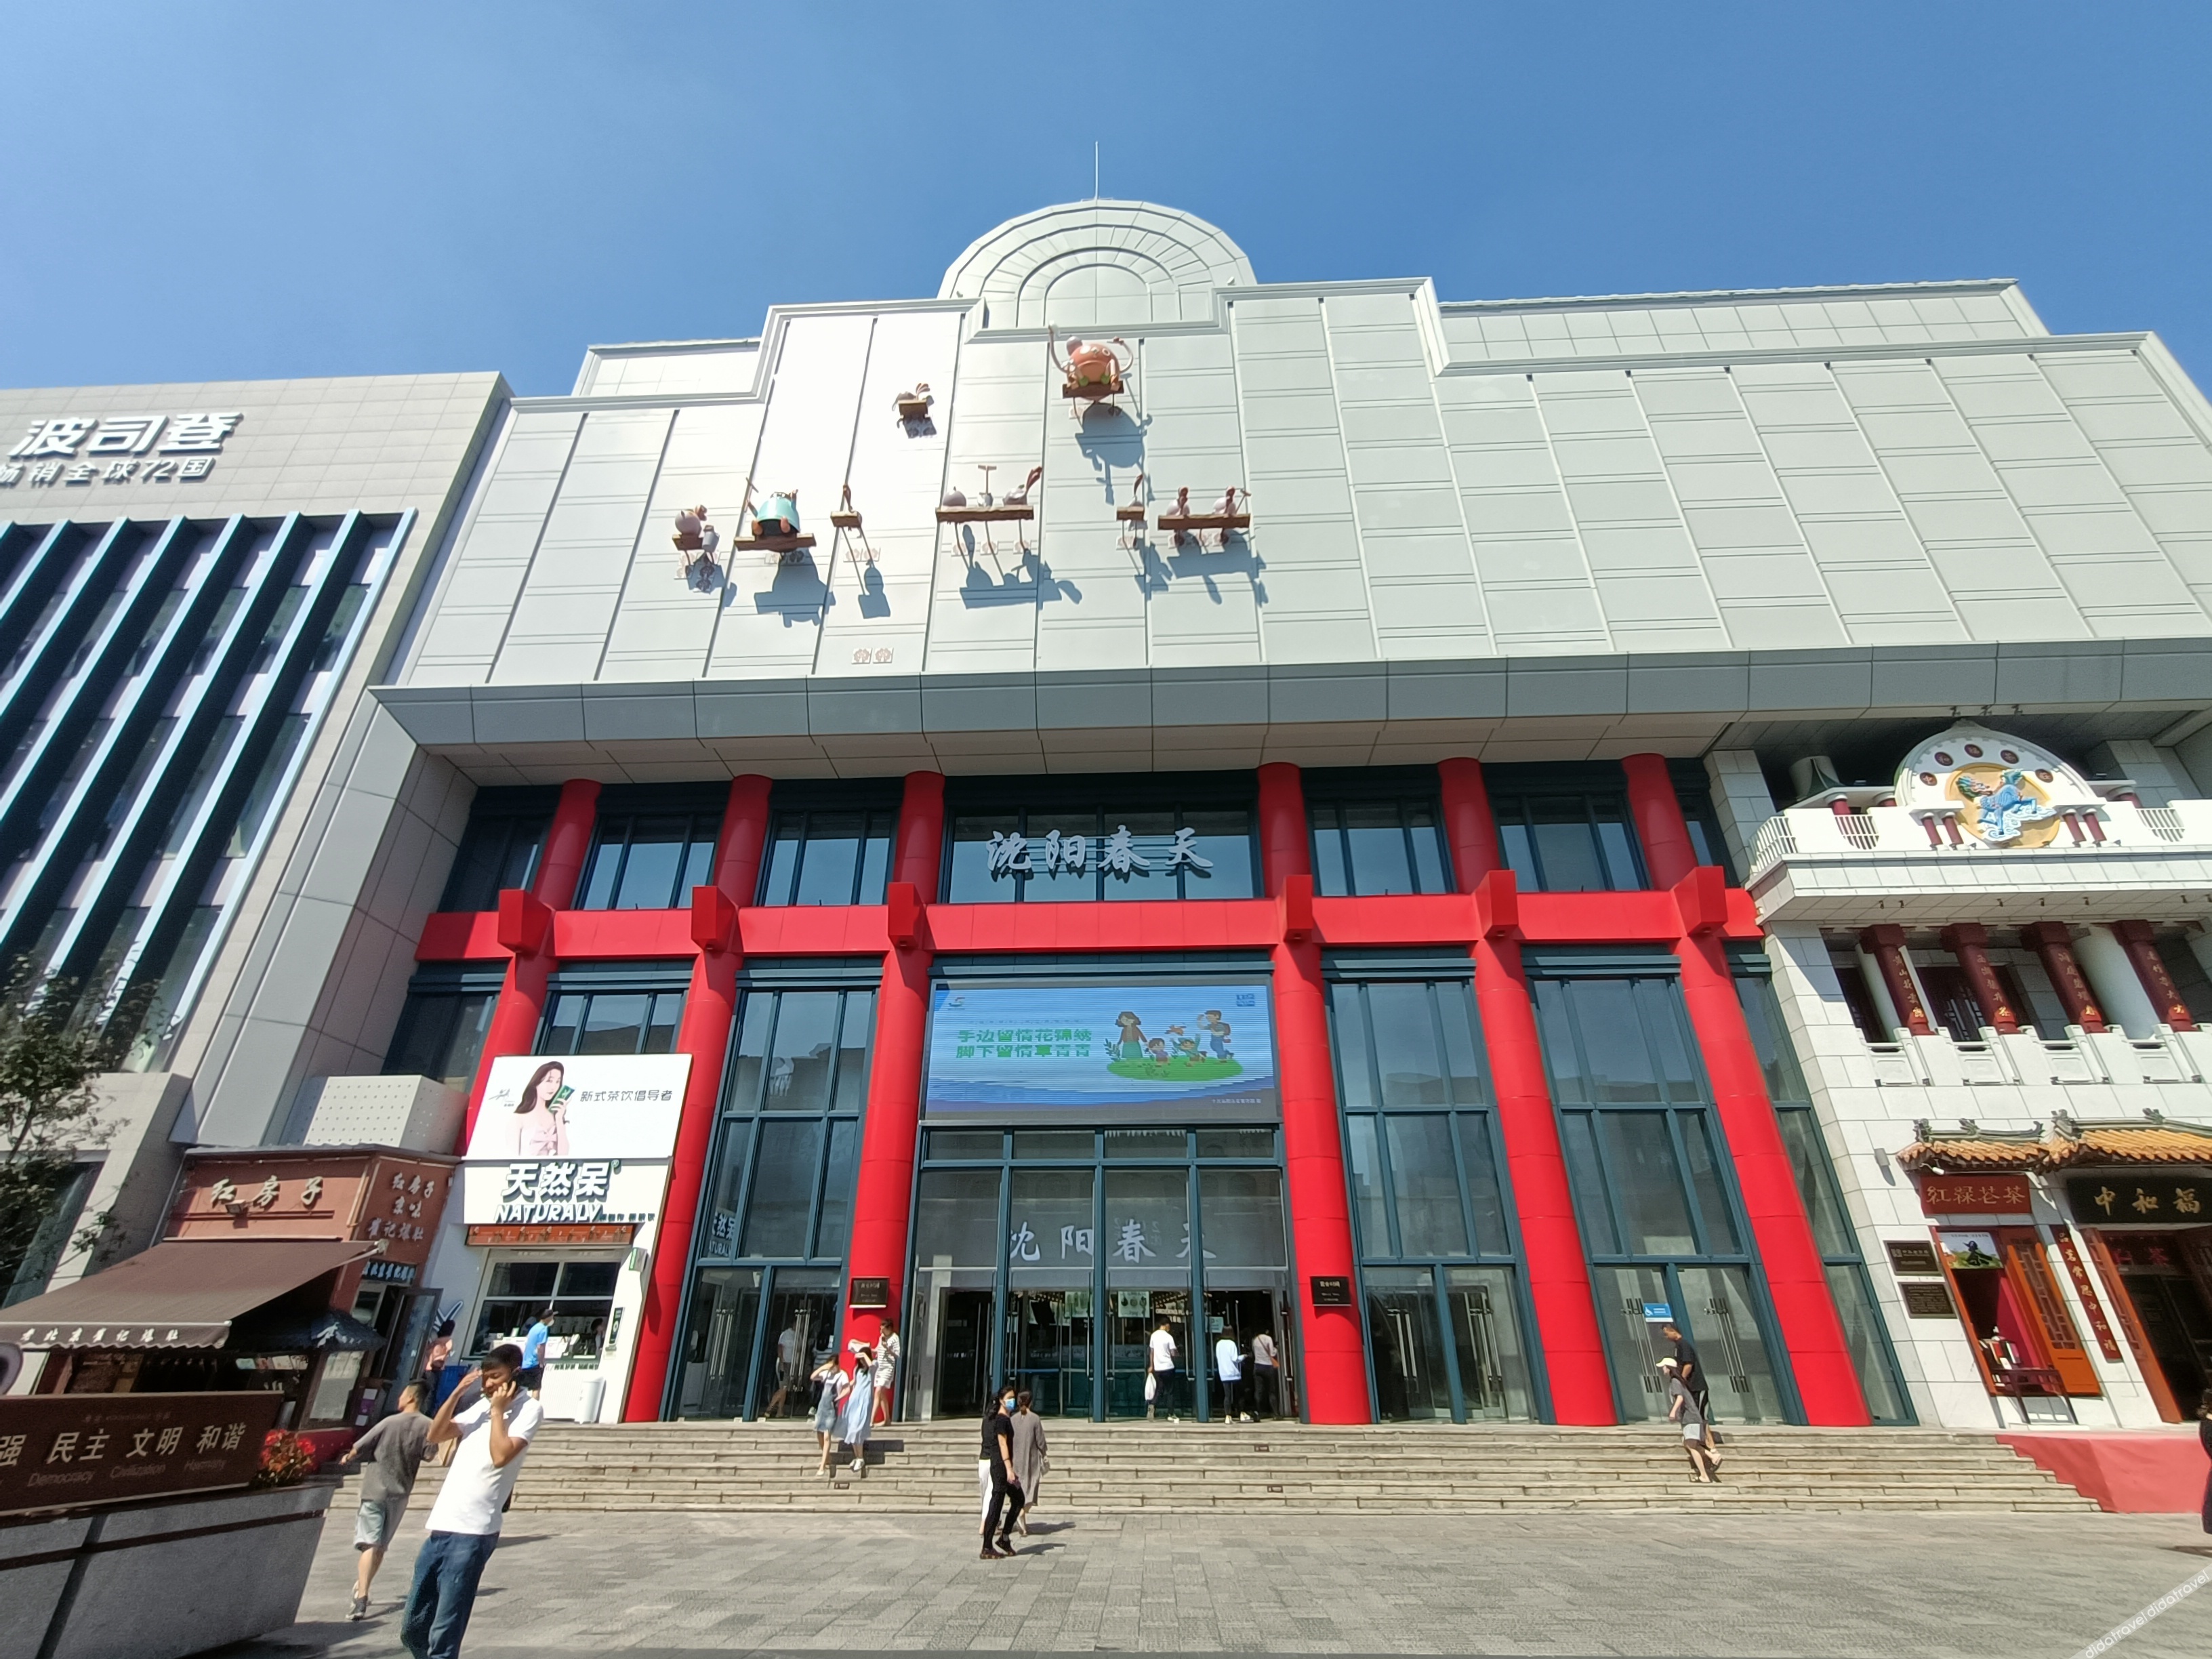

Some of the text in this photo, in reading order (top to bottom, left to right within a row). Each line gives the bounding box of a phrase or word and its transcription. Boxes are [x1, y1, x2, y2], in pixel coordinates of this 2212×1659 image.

[7, 412, 243, 456] 波司登
[986, 825, 1214, 873] 沈阳春天
[579, 1090, 673, 1102] 新式茶饮倡导者
[211, 1174, 324, 1208] 红房子
[501, 1161, 611, 1198] 天然呆
[494, 1204, 602, 1223] NATURALY
[46, 1428, 110, 1465] 民主
[125, 1427, 184, 1458] 文明
[196, 1422, 247, 1454] 和谐
